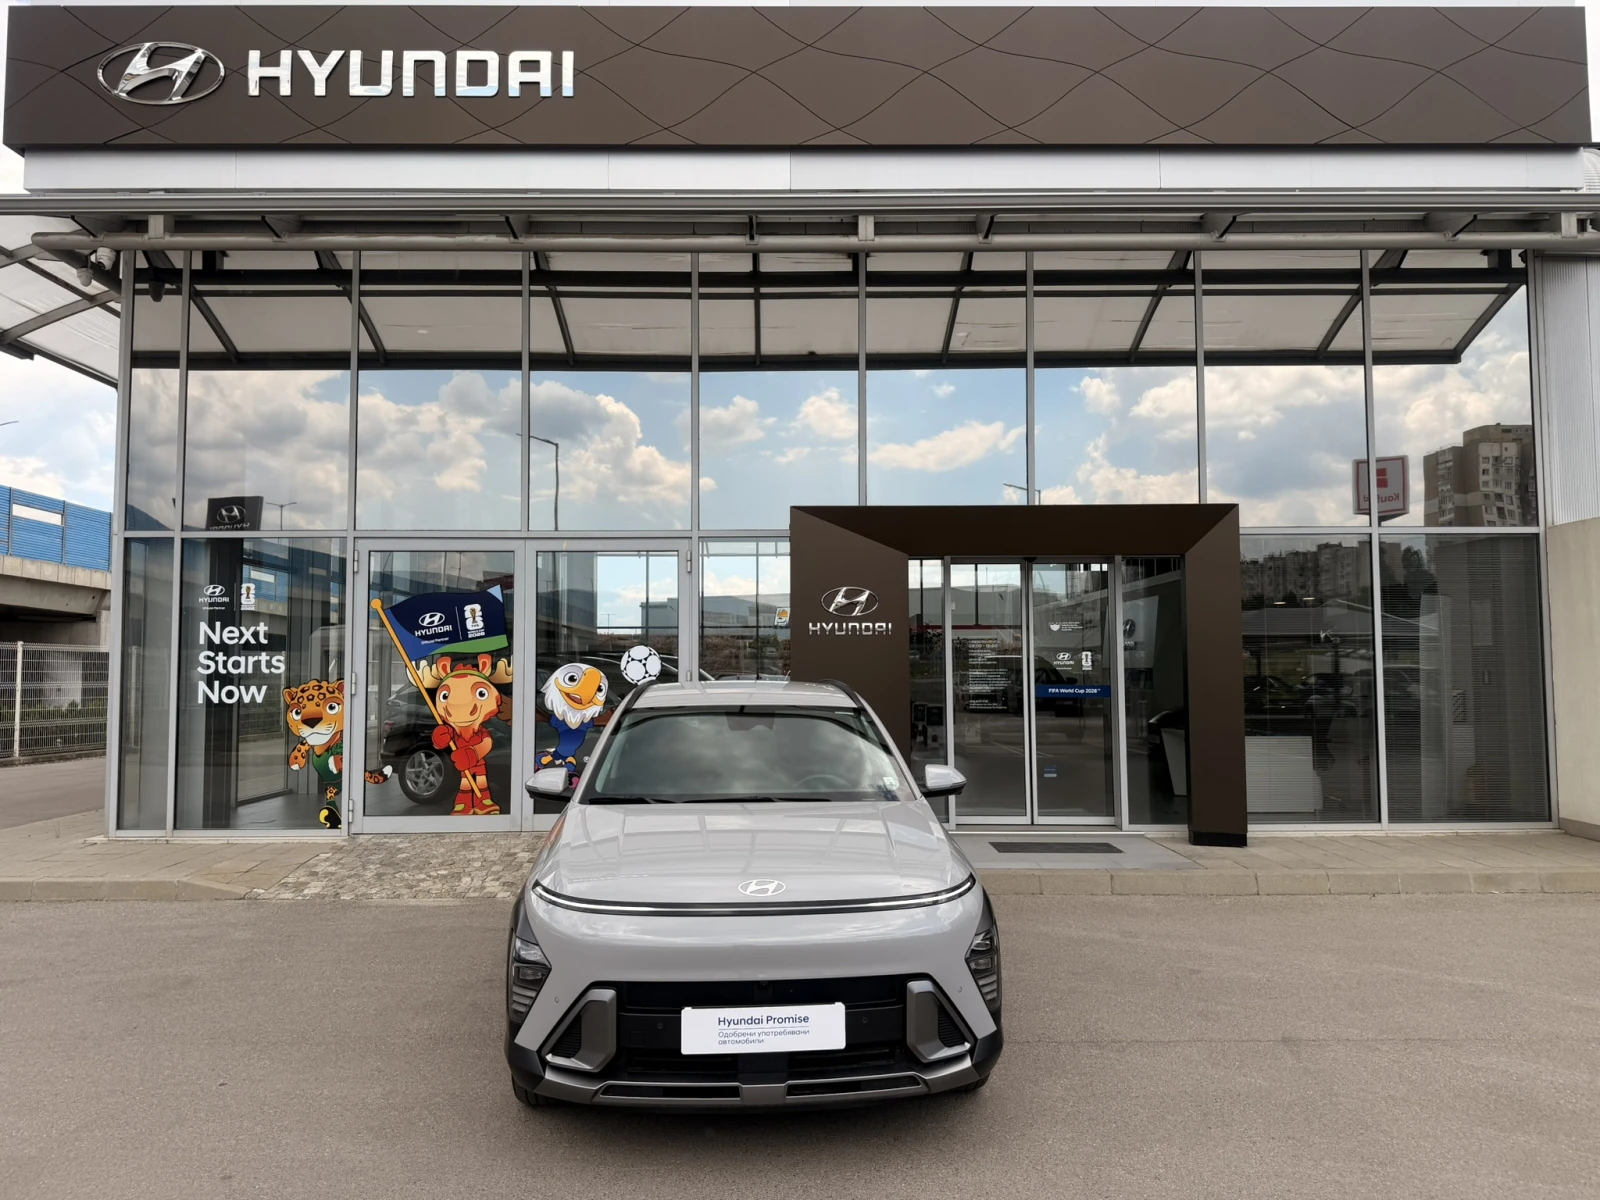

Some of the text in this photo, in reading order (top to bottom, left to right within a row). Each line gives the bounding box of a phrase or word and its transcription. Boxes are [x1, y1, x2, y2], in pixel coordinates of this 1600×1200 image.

[248, 50, 574, 97] HYUNDAI
[199, 622, 268, 644] Next
[415, 625, 452, 637] HYUNDAI
[808, 622, 892, 635] HYUNDAI
[197, 650, 286, 674] Starts
[198, 680, 268, 704] Now
[718, 1014, 810, 1027] Hyundai Promise
[718, 1029, 810, 1038] Одобрени употребявани
